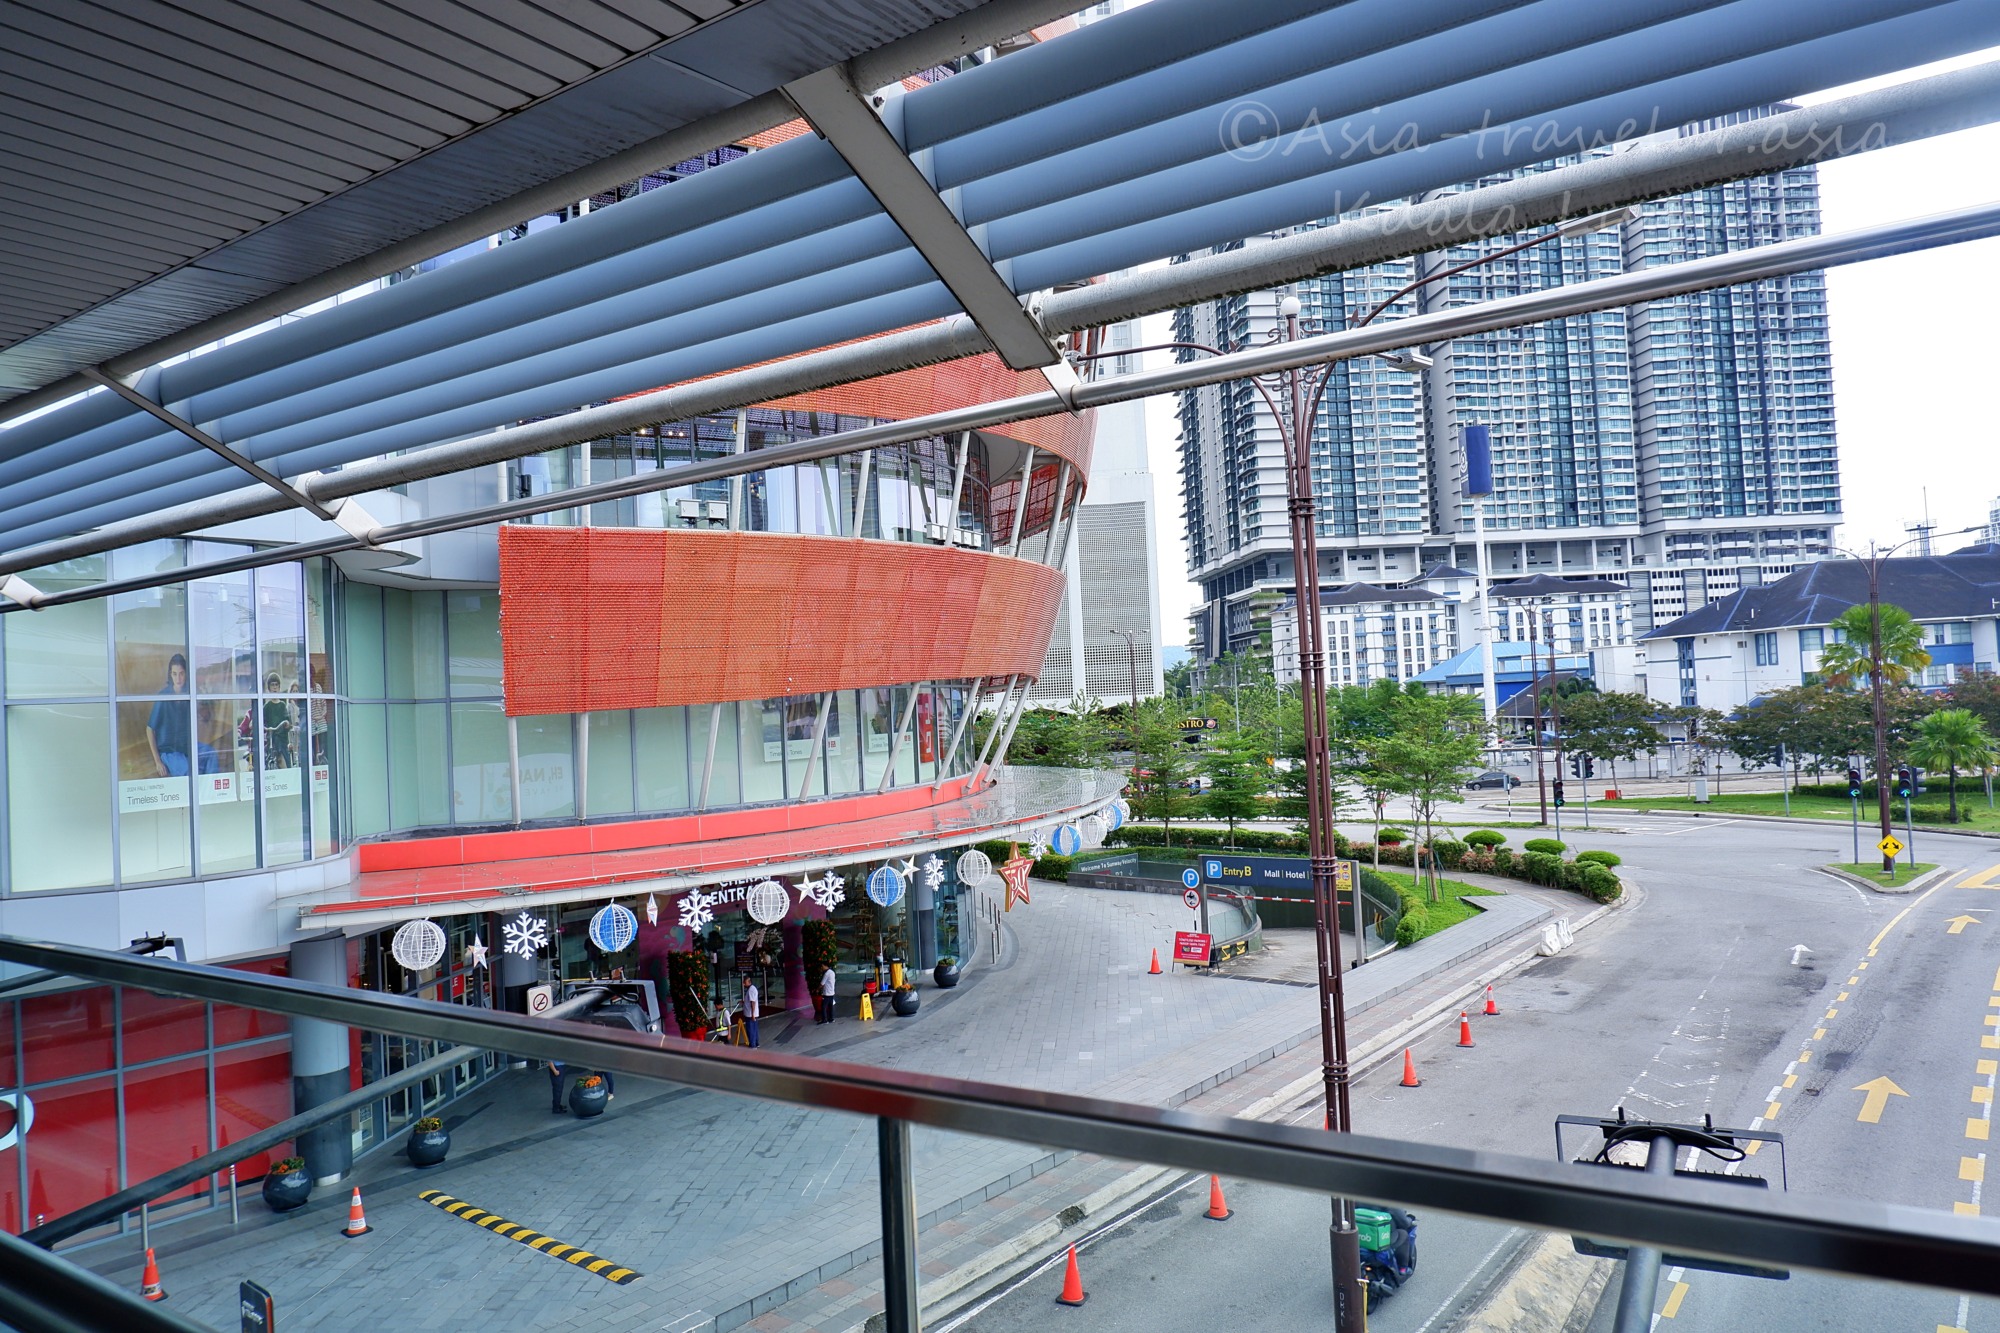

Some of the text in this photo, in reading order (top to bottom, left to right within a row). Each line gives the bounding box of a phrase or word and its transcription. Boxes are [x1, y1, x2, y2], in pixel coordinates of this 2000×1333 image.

[1177, 719, 1204, 729] ISTRO
[127, 793, 180, 806] Timeless Tones
[1081, 864, 1101, 872] Welcome
[1107, 860, 1122, 868] Sunway
[1223, 867, 1244, 878] Entry
[1244, 866, 1252, 876] B
[1264, 869, 1280, 878] Mall
[1285, 871, 1306, 879] Hotel
[1358, 1232, 1372, 1242] rab
